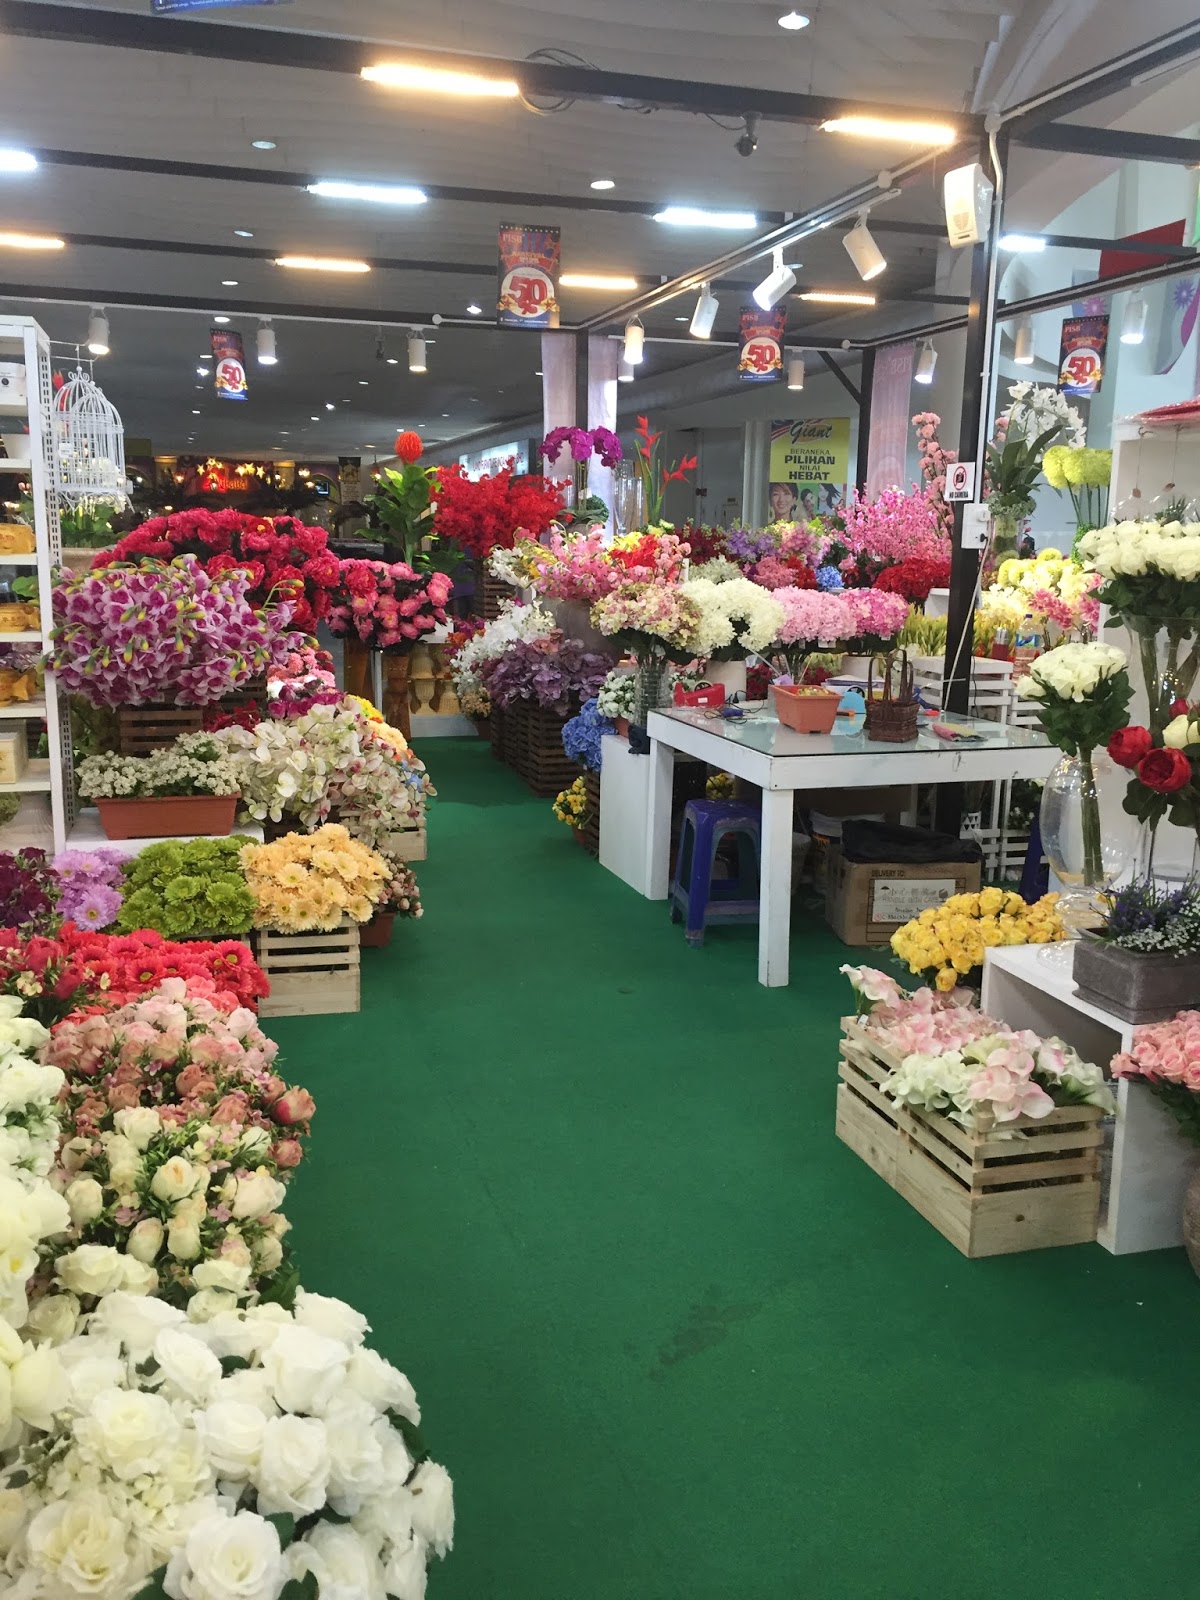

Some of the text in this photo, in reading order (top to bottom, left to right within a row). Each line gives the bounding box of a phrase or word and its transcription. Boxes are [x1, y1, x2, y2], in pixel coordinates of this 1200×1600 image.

[790, 420, 833, 445] Giant
[784, 455, 836, 465] PILIHAN
[788, 471, 830, 481] HEBAT
[871, 869, 896, 877] DELIVERY
[883, 896, 905, 904] HANDLE
